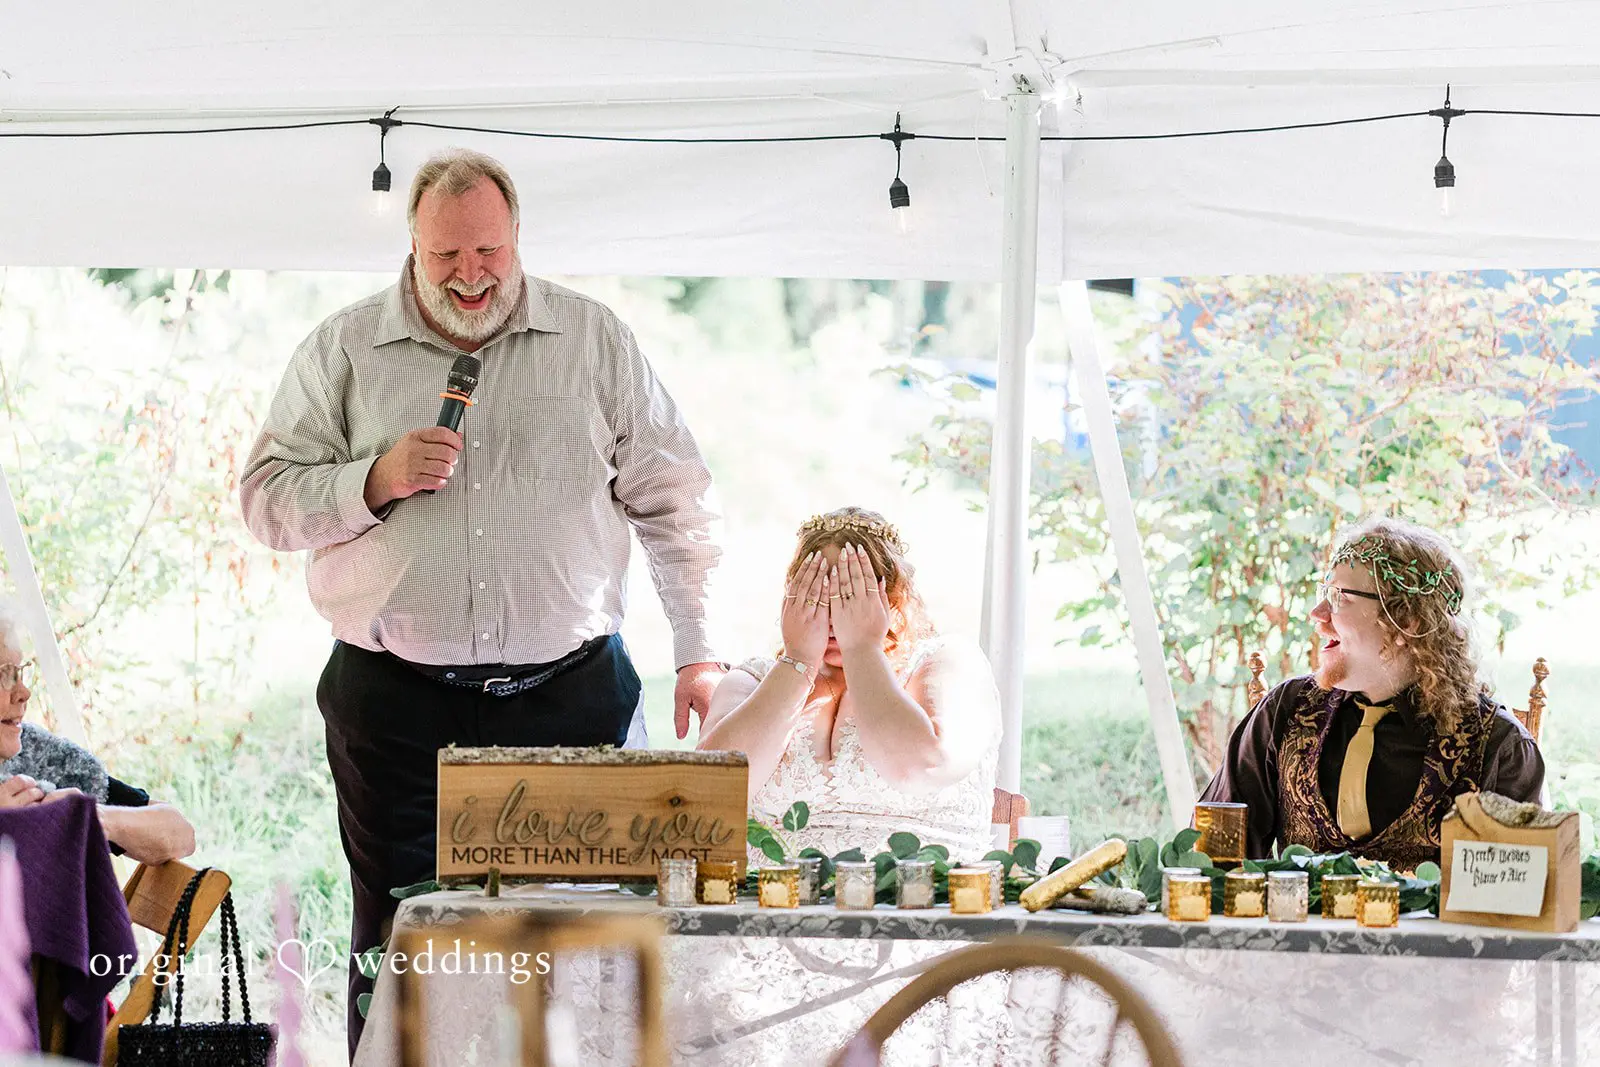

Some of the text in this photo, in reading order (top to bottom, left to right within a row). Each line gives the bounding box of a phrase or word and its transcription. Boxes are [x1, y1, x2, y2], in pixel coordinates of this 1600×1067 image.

[451, 778, 735, 867] i love you
[451, 846, 713, 865] MORE THAN THE MOST
